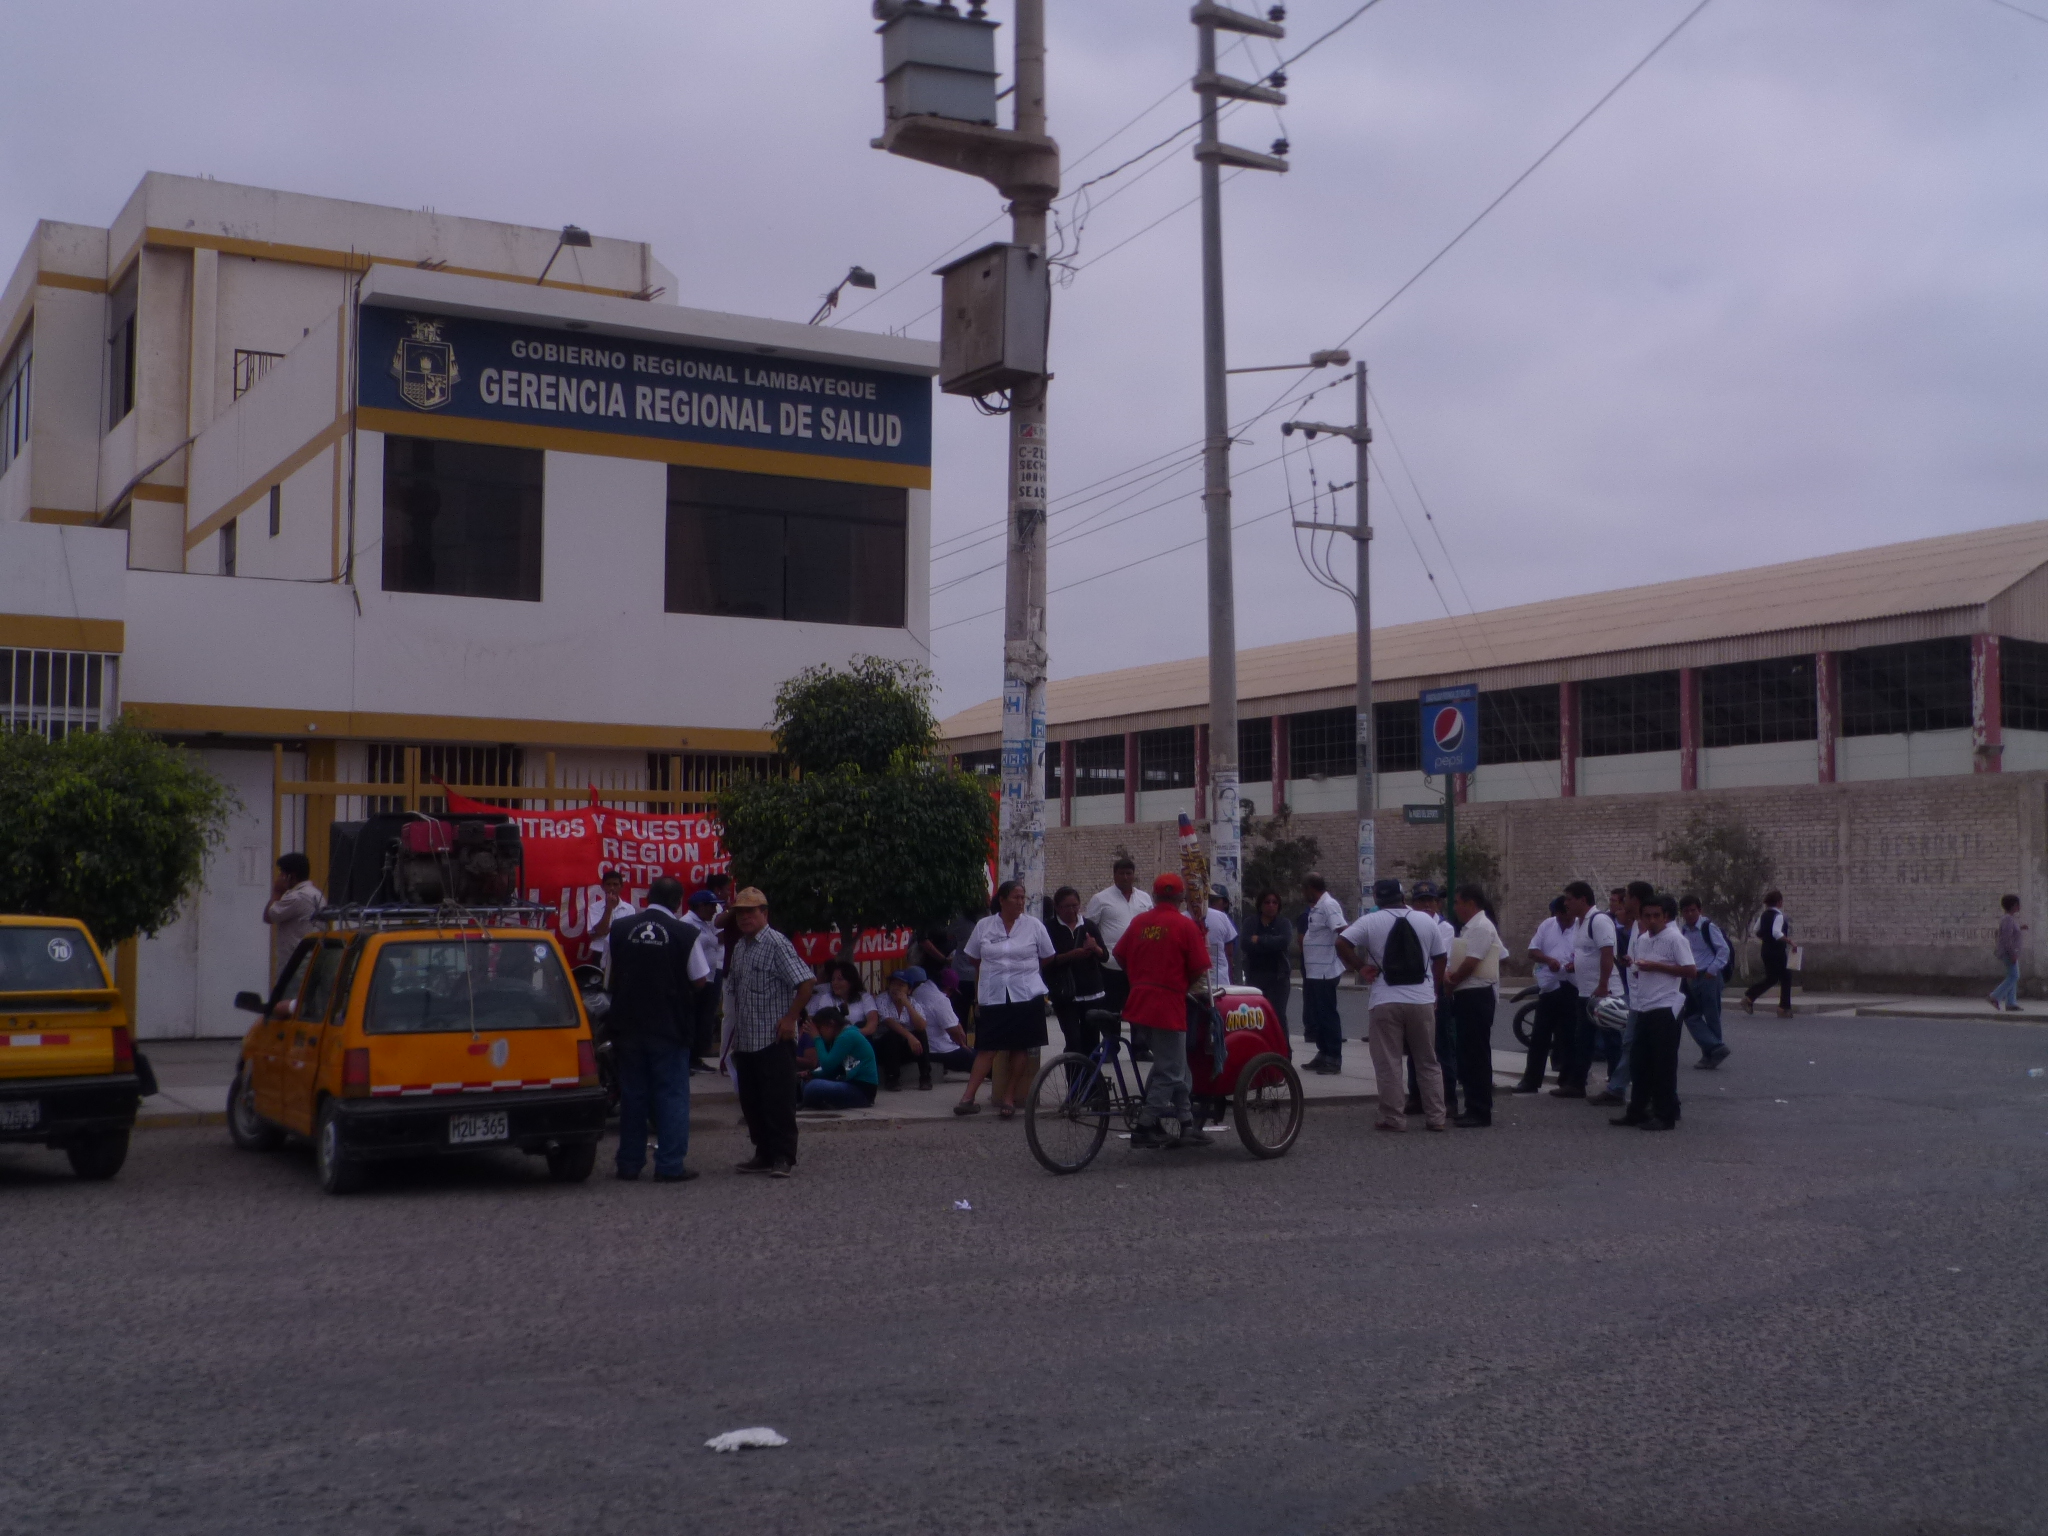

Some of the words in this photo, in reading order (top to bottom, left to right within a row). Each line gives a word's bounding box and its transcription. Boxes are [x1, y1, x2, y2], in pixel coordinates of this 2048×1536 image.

[510, 339, 626, 370] GOBIERNO
[633, 353, 739, 384] REGIONAL
[744, 368, 877, 400] LAMBAYEQUE
[479, 367, 627, 418] GERENCIA
[635, 385, 771, 435] REGIONAL
[779, 402, 813, 439] DE
[820, 407, 902, 448] SALUD
[1018, 446, 1046, 460] C-21
[1434, 752, 1463, 769] pepsi
[591, 813, 606, 834] Y
[602, 837, 699, 863] REGION
[597, 861, 664, 885] CGTP
[52, 946, 68, 958] 70
[801, 937, 817, 956] Y
